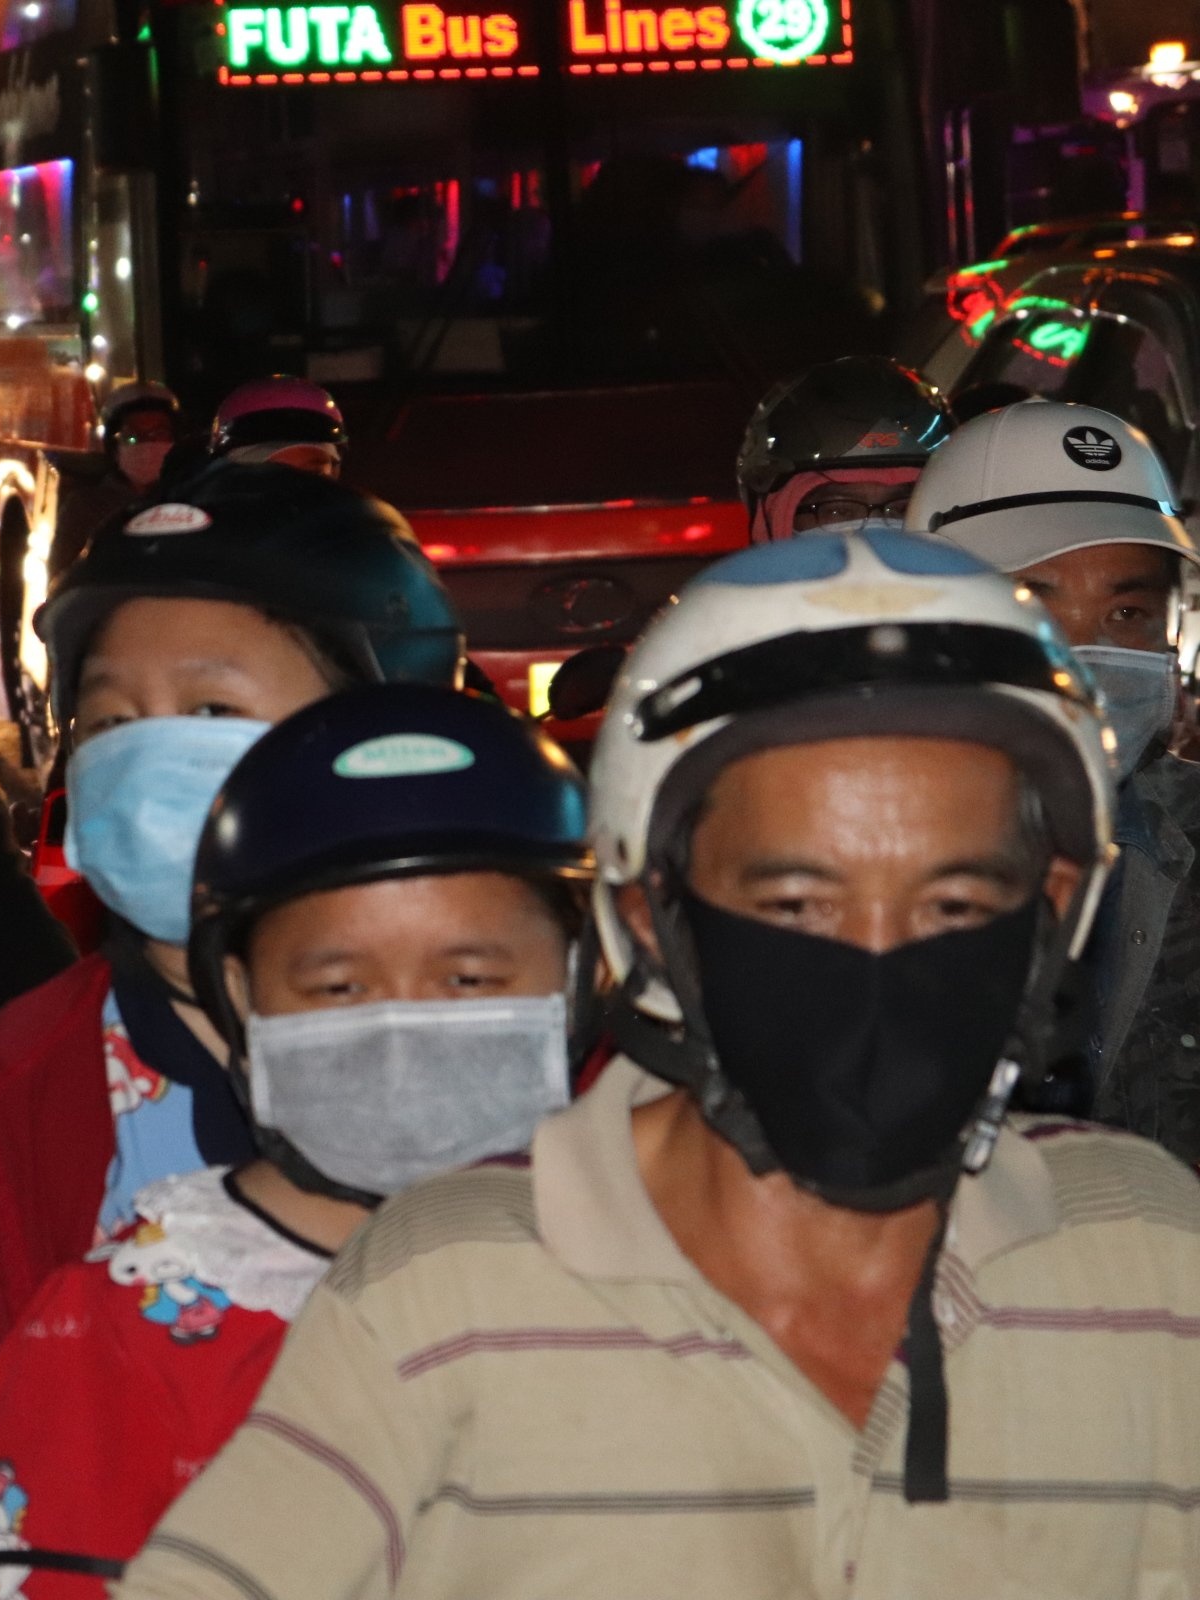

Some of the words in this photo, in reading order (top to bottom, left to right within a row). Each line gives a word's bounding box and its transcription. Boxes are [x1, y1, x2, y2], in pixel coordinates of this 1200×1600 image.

[227, 5, 391, 66] FUTA
[402, 4, 519, 58] Bus
[570, 0, 730, 54] Lines
